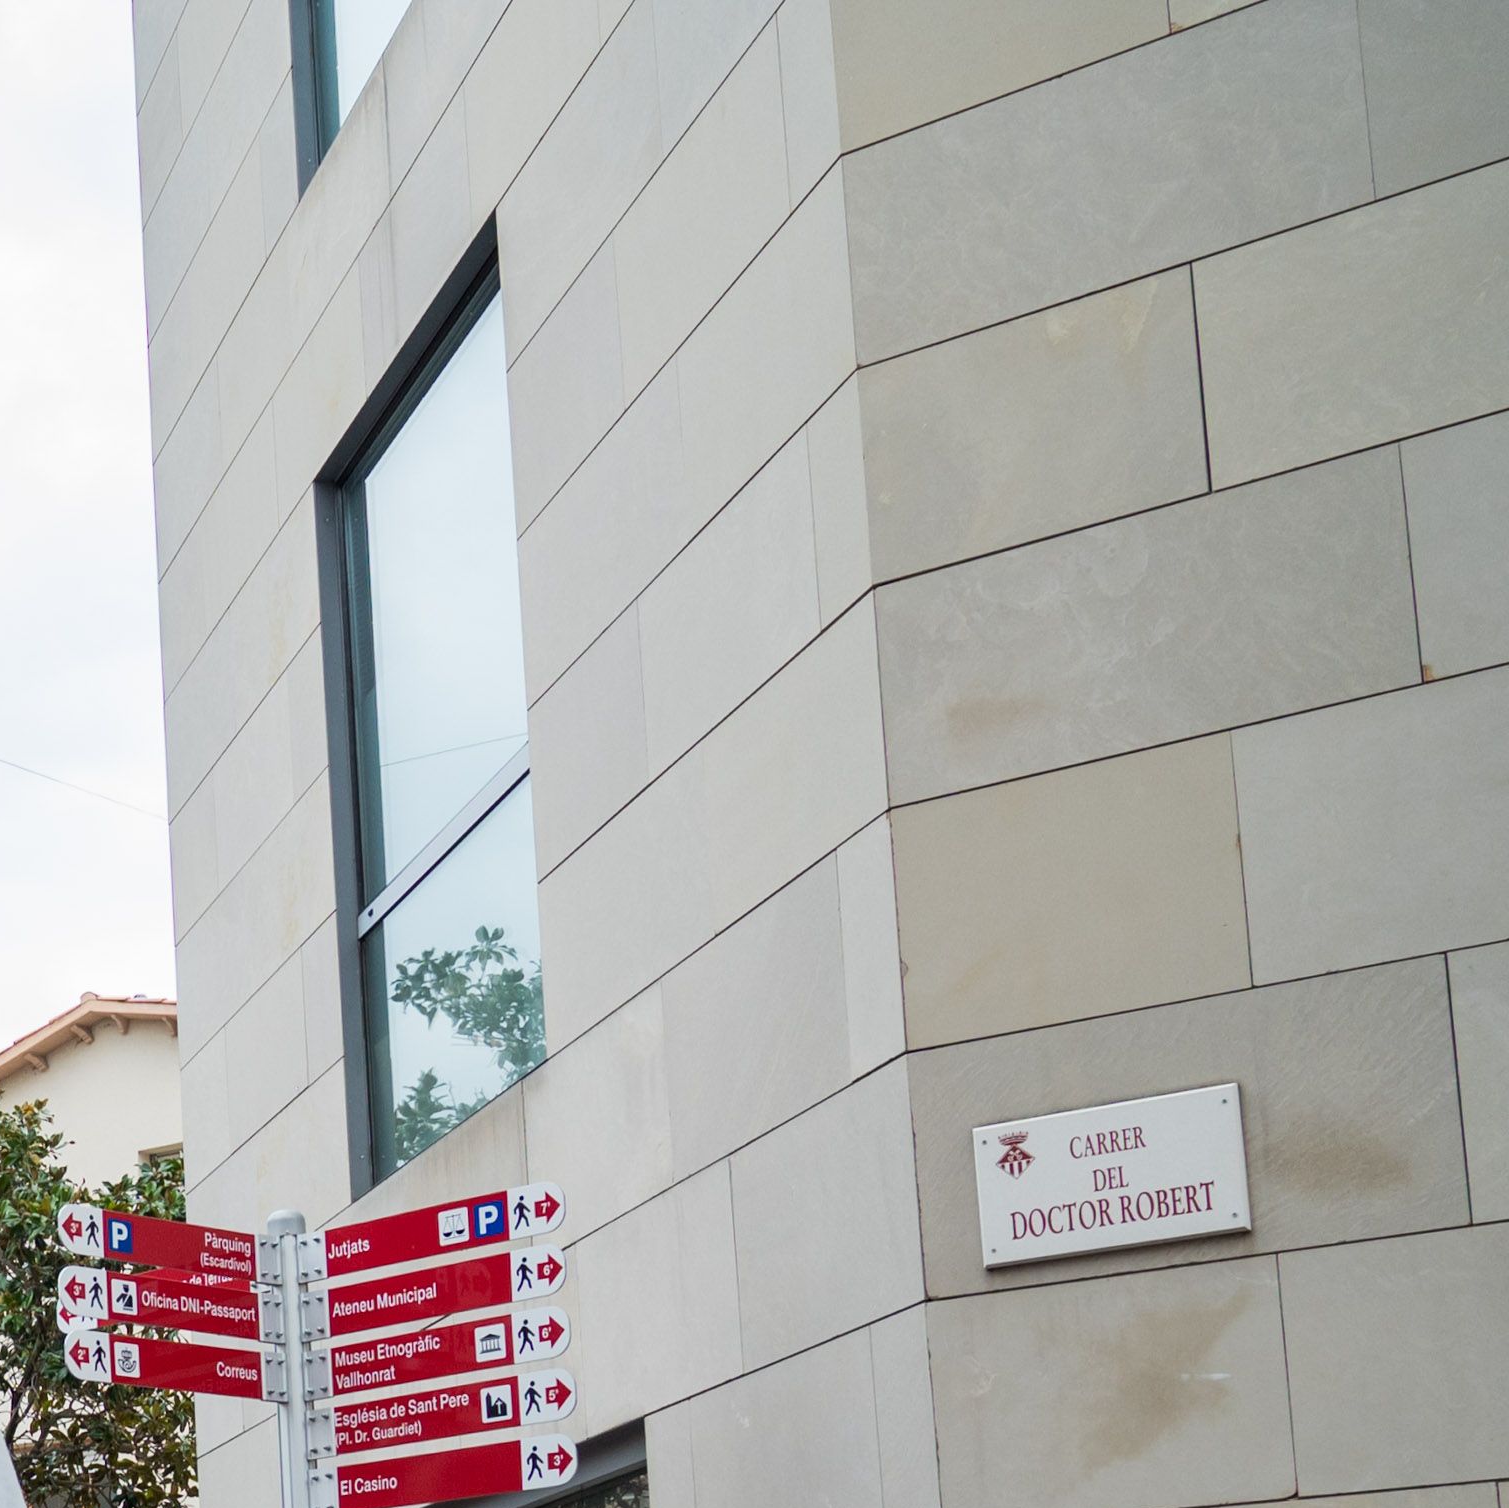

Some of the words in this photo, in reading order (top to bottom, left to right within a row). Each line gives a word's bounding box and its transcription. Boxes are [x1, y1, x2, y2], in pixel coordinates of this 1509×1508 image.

[1069, 1126, 1147, 1159] CARRER
[1093, 1165, 1129, 1192] DEL
[1010, 1197, 1115, 1240] DOCTOR
[1119, 1181, 1215, 1224] ROBERT
[204, 1232, 252, 1257] Pàrquing
[328, 1238, 370, 1260] Jutjats
[200, 1252, 252, 1275] (Escardívol)
[141, 1291, 179, 1311] Oficina
[181, 1297, 256, 1321] DNI-Passaport
[332, 1297, 374, 1317] Ateneu
[377, 1282, 437, 1309] Municipal
[335, 1348, 374, 1368] Museu
[377, 1334, 441, 1361] Etnogràfic
[216, 1361, 258, 1381] Correus
[335, 1365, 396, 1389] Vallhonrat
[335, 1403, 387, 1429] Església
[391, 1401, 406, 1418] de
[408, 1396, 438, 1416] Sant
[440, 1392, 470, 1409] Pere
[355, 1428, 370, 1445] Dr.
[372, 1420, 422, 1441] Guardiet)
[340, 1479, 352, 1496] El
[355, 1475, 398, 1494] Casino
